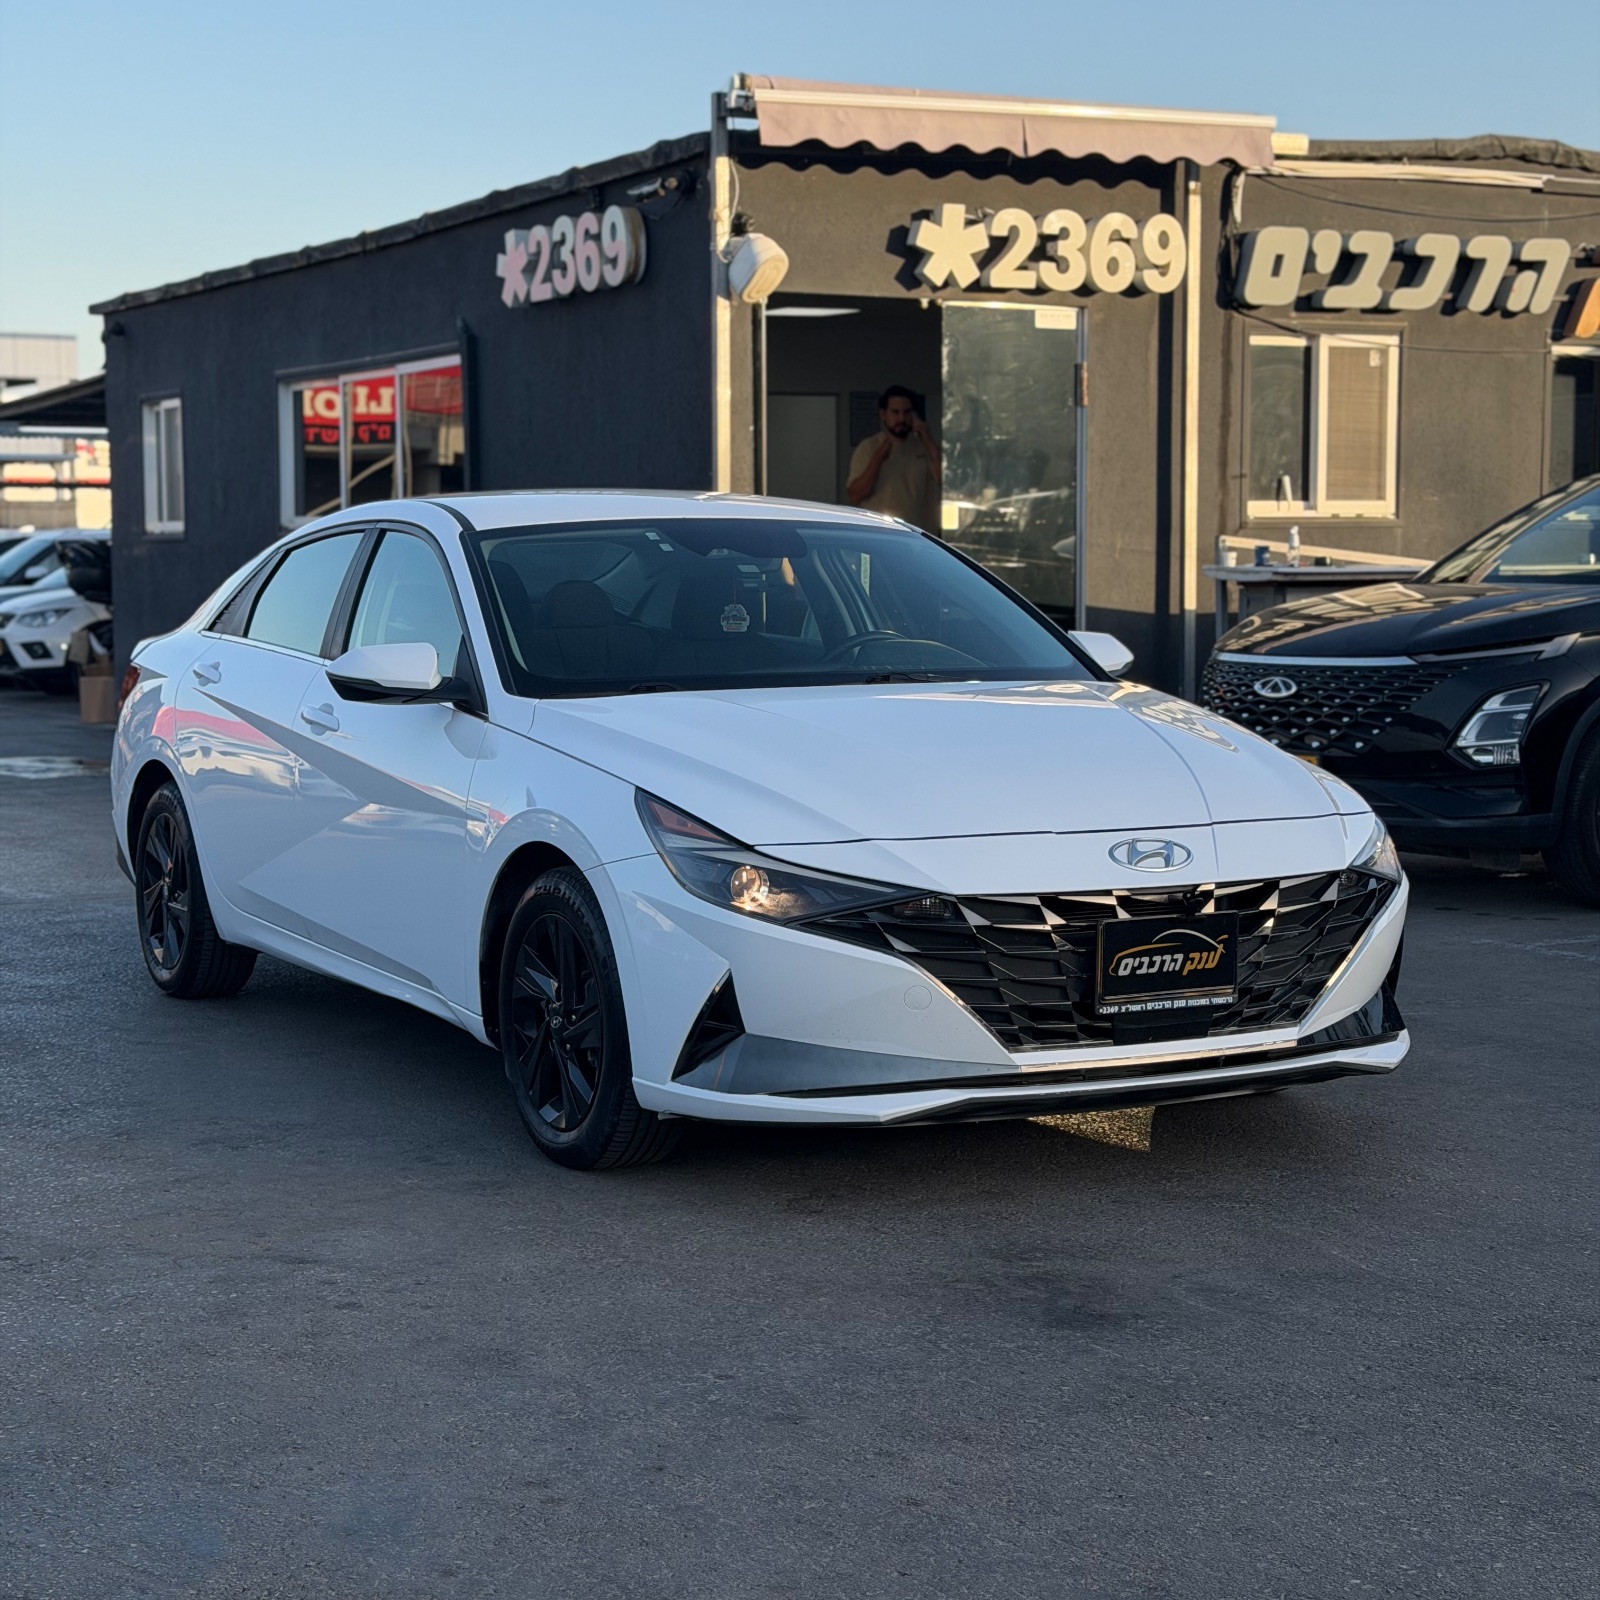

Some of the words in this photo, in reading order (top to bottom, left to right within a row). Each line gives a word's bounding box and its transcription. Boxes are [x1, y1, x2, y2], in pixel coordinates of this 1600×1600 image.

[1238, 225, 1571, 315] הרכבים
[1117, 953, 1184, 977] הרכבים
[1182, 944, 1225, 976] ענק
[1146, 1000, 1172, 1010] הרכבים
